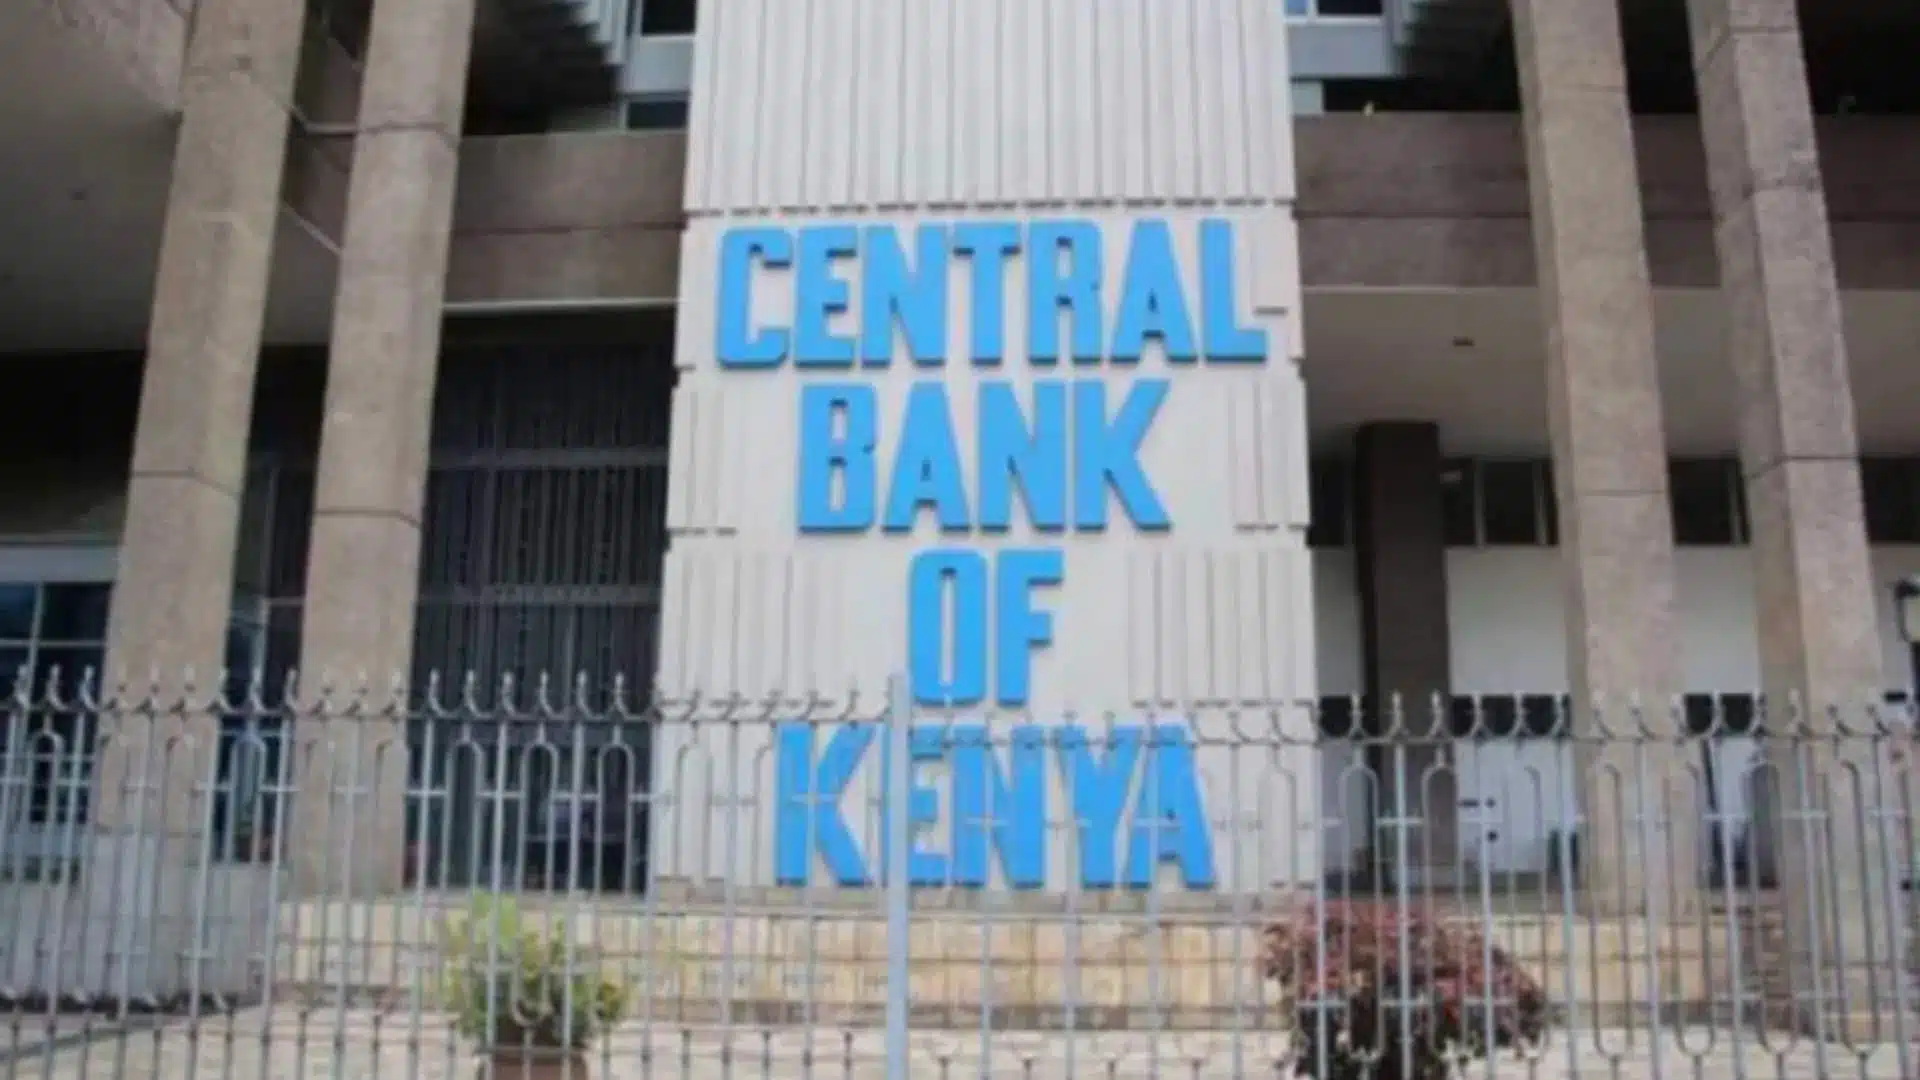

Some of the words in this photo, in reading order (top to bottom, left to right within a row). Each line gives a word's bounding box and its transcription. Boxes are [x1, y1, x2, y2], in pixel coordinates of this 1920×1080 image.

[716, 219, 1268, 369] CENTRAL
[797, 379, 1170, 533] BANK
[907, 548, 1064, 708] OF
[774, 722, 1215, 890] KENYA
